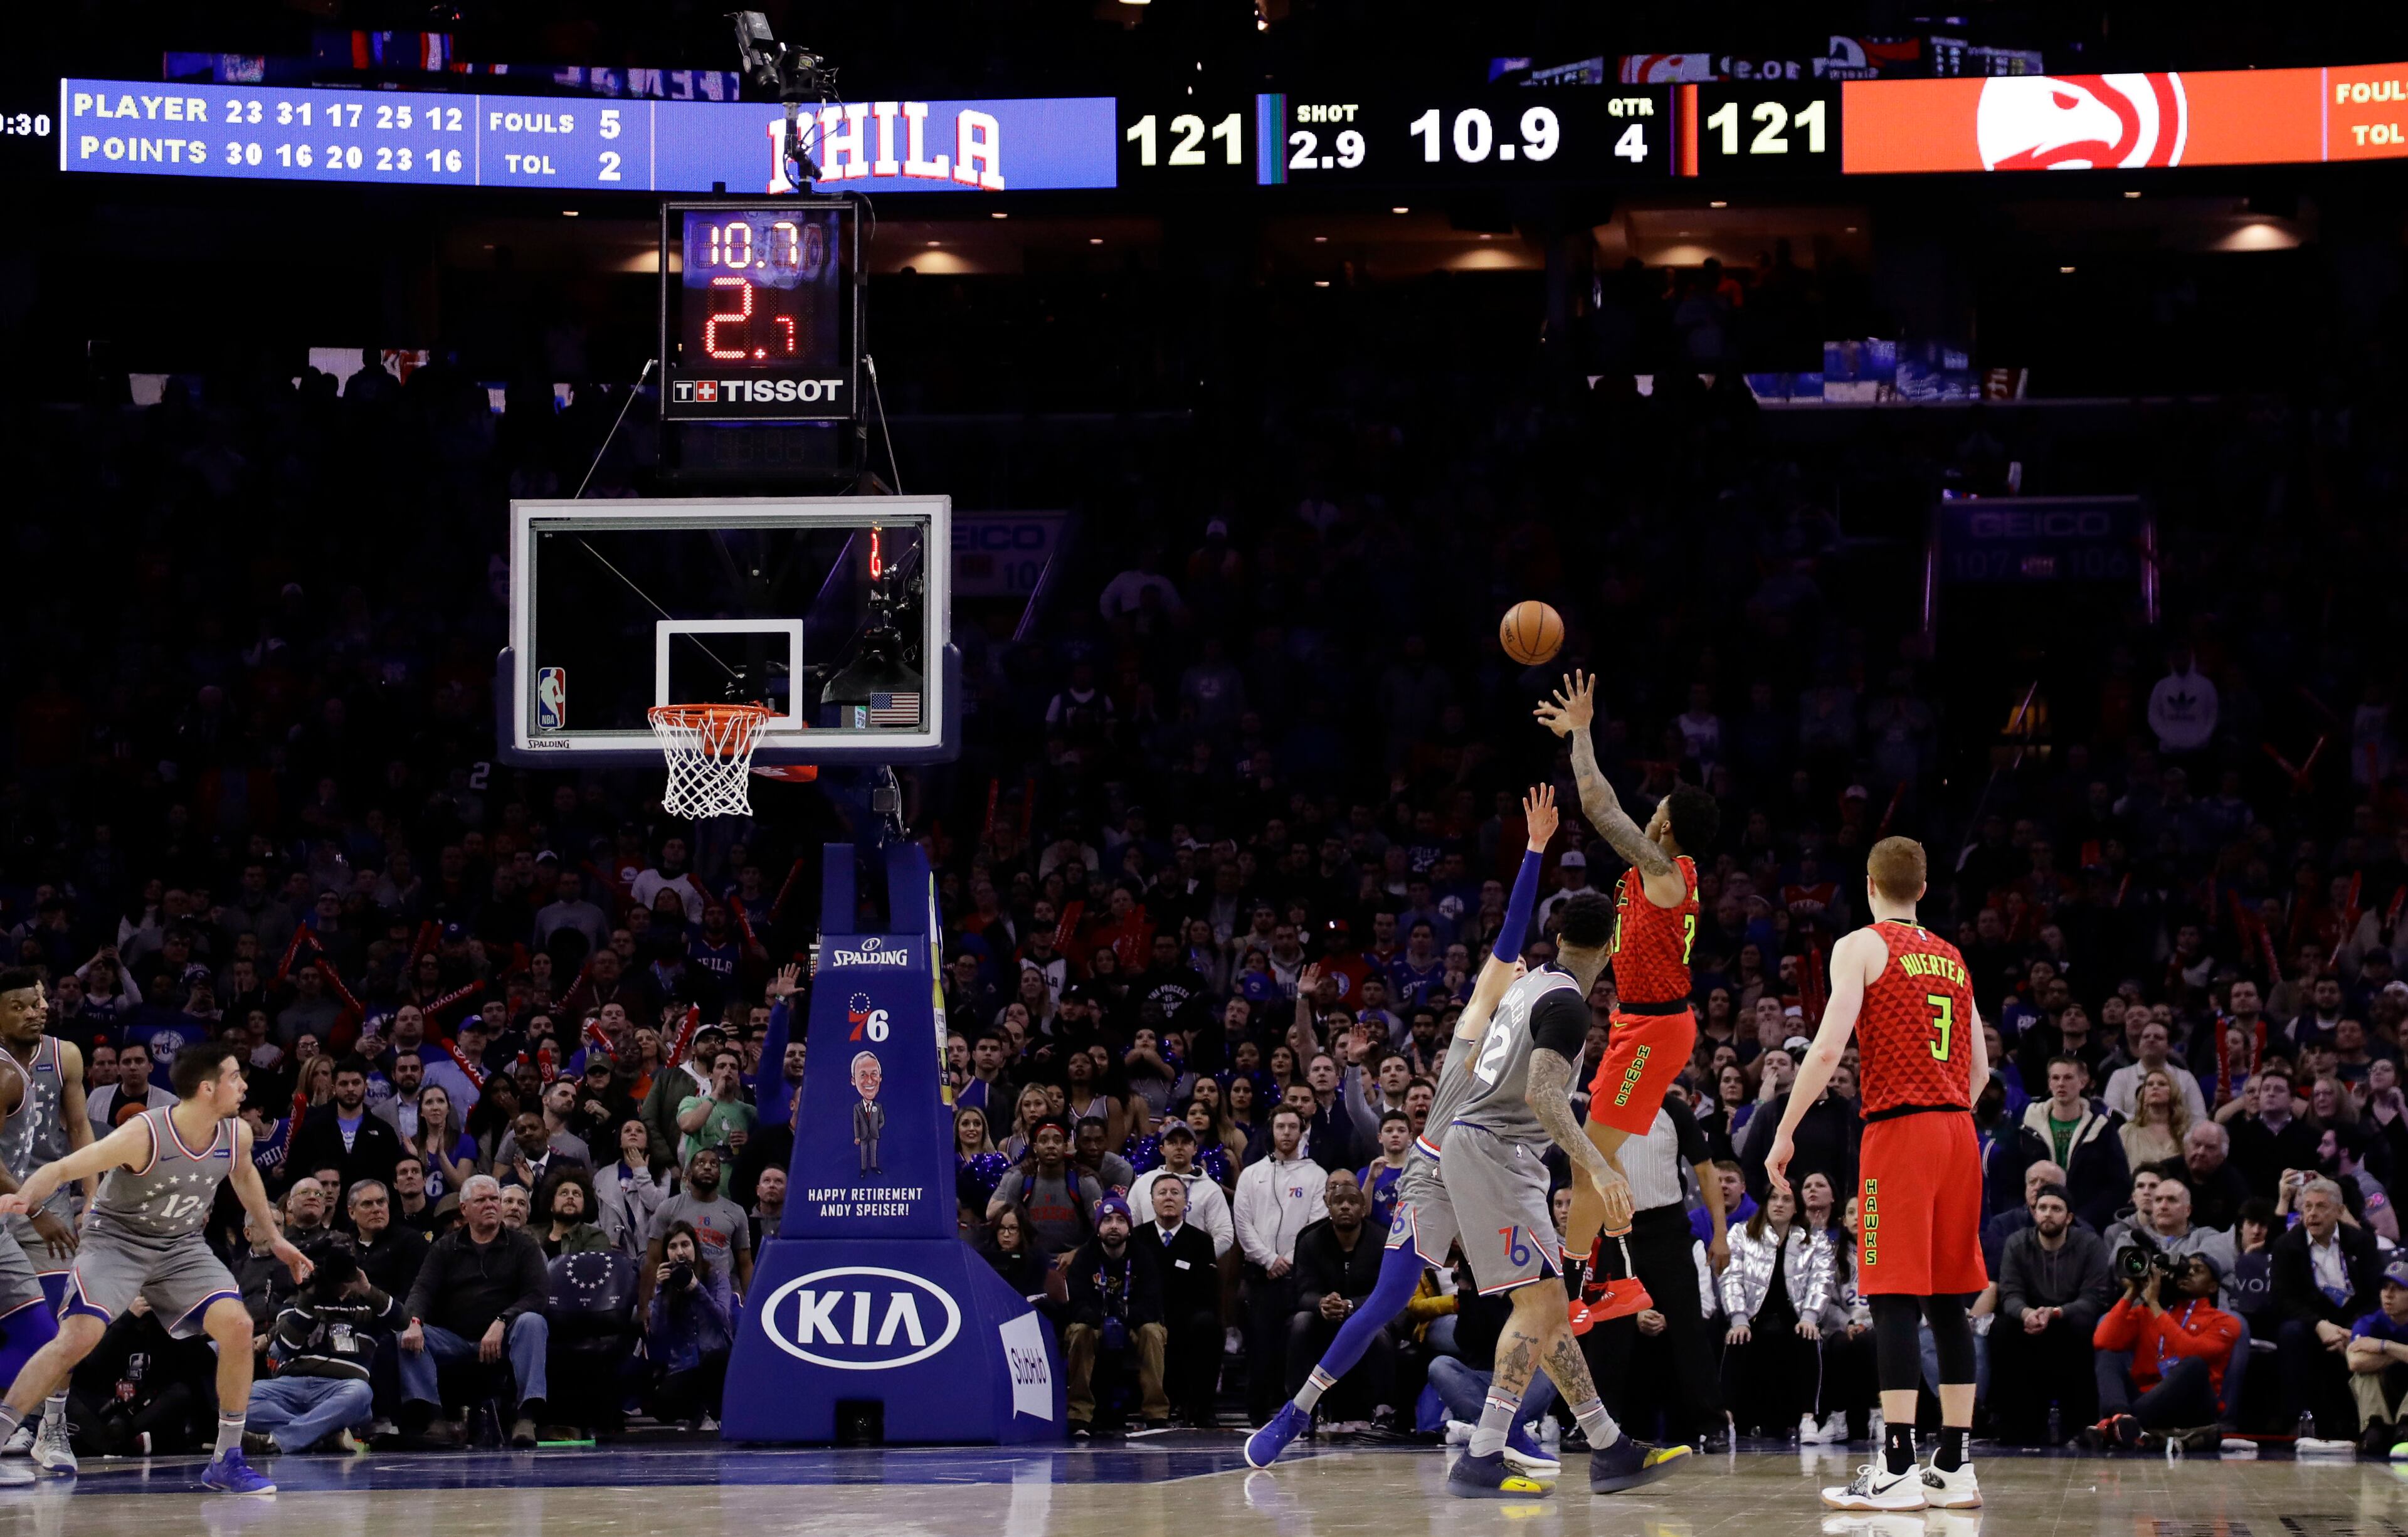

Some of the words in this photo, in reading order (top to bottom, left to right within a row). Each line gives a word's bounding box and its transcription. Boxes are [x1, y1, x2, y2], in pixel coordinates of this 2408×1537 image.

[1607, 98, 1654, 117] QTR
[2336, 80, 2408, 105] FOUL
[74, 93, 208, 122] PLAYER
[226, 100, 263, 124] 23
[277, 102, 312, 126] 31
[326, 104, 362, 127] 17
[376, 105, 413, 129] 25
[426, 107, 462, 131] 12
[490, 112, 574, 134] FOULS
[599, 110, 621, 139] 5
[1297, 104, 1359, 122] SHOT
[1707, 100, 1827, 154] 121
[767, 102, 1005, 194] PHILA
[1127, 113, 1243, 167] 121
[1289, 130, 1366, 169] 2.9
[1409, 107, 1560, 162] 10.9
[1613, 124, 1649, 163] 4
[2352, 123, 2405, 145] TOL
[80, 135, 207, 163] POINTS
[226, 142, 263, 166] 30
[276, 144, 313, 167] 16
[326, 145, 362, 169] 20
[376, 147, 413, 171] 23
[426, 149, 462, 172] 16
[505, 154, 556, 175] TOL
[598, 152, 621, 181] 2
[711, 222, 798, 268] 10.7
[706, 277, 793, 358] 2.7
[721, 379, 843, 401] TISSOT
[1970, 512, 2111, 539] GEICO
[542, 715, 555, 725] NBA
[527, 740, 570, 749] SPALDING
[470, 762, 490, 790] 2
[833, 949, 907, 967] SPALDING
[1899, 953, 1966, 988] HUERTER
[847, 1009, 889, 1043] 76
[1928, 993, 1953, 1062] 3
[1614, 1044, 1651, 1106] HAWKS
[160, 1194, 200, 1218] 12
[808, 1189, 847, 1202] HAPPY
[851, 1187, 923, 1202] RETIREMENT
[1289, 1186, 1302, 1198] 76
[820, 1204, 852, 1217] ANDY
[856, 1203, 910, 1217] SPEISER!
[1865, 1179, 1879, 1264] HAWKS
[1498, 1225, 1531, 1267] 76
[797, 1289, 927, 1346] KIA
[1011, 1348, 1047, 1385] StubHub
